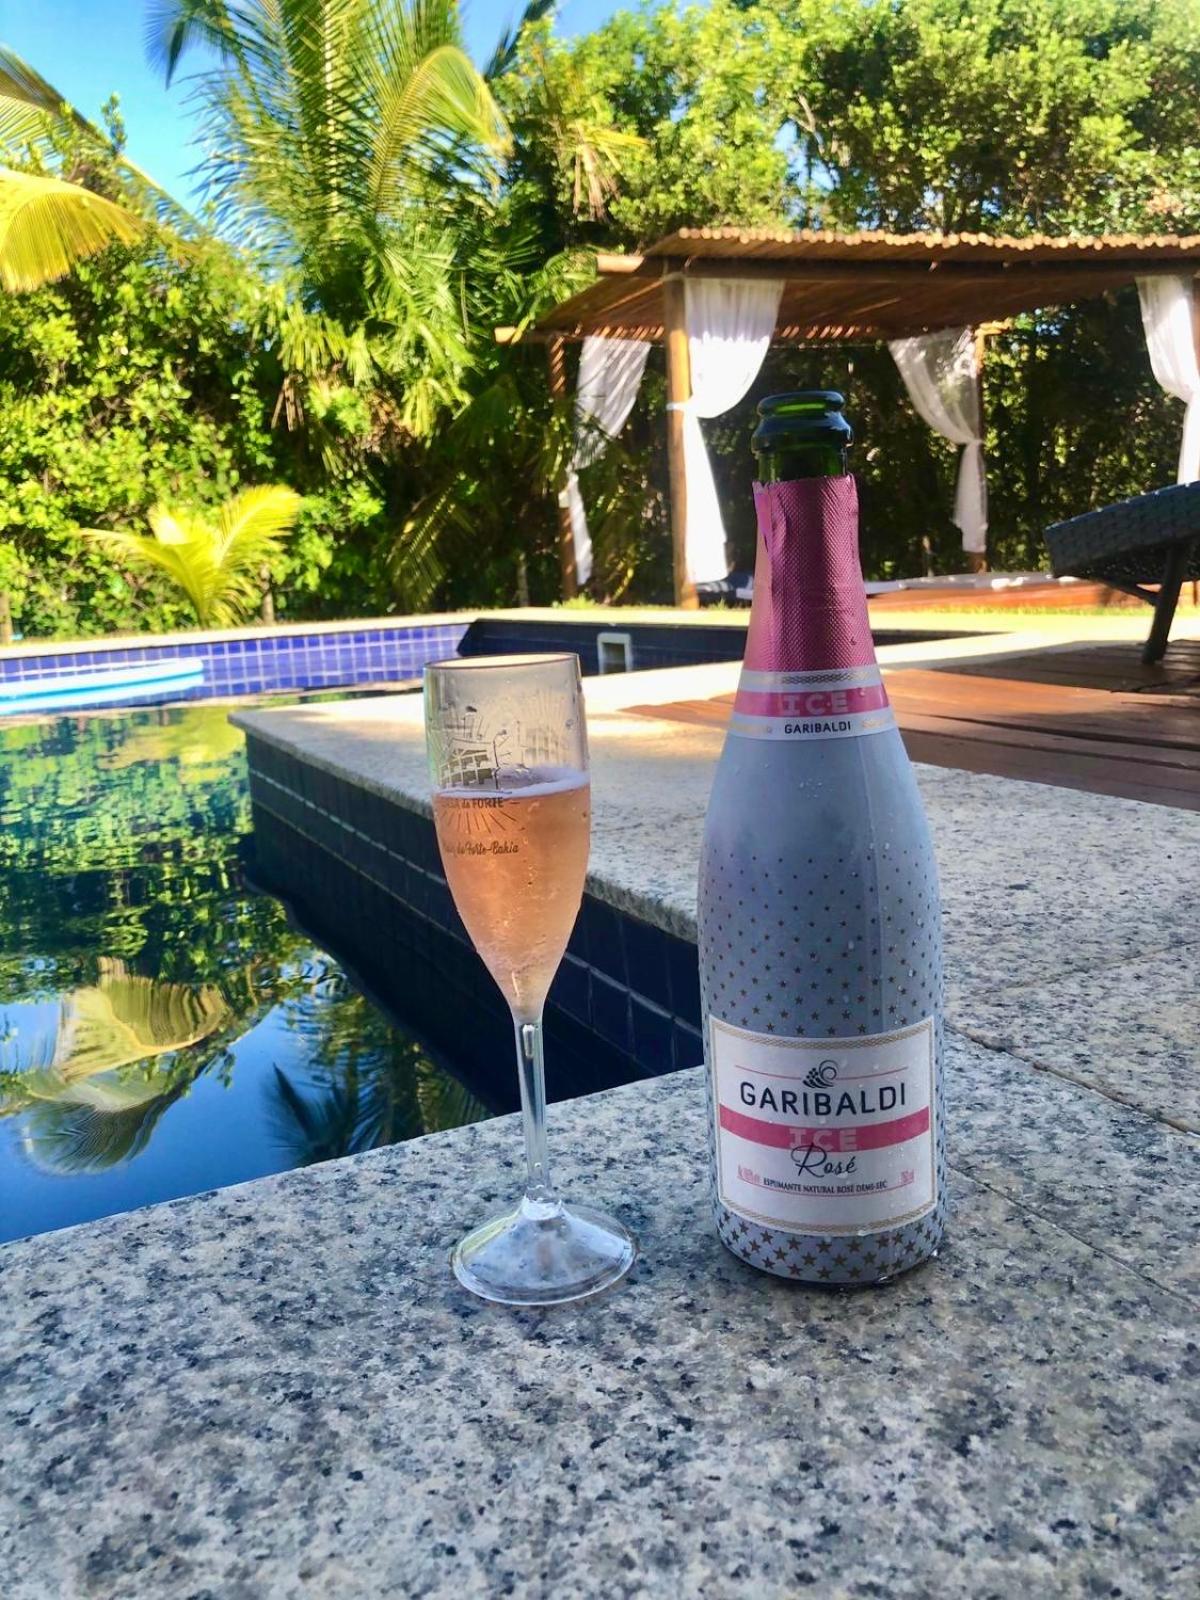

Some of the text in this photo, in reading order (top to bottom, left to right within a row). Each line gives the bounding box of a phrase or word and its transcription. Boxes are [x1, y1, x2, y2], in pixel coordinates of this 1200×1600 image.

[783, 692, 849, 715] ICE
[784, 721, 851, 734] GARIBALDI
[740, 1081, 906, 1116] GARIBALDI
[789, 1128, 858, 1150] ICE
[790, 1143, 858, 1178] Rosé
[763, 1177, 801, 1192] ESPUMANTE
[803, 1184, 835, 1194] NATURAL
